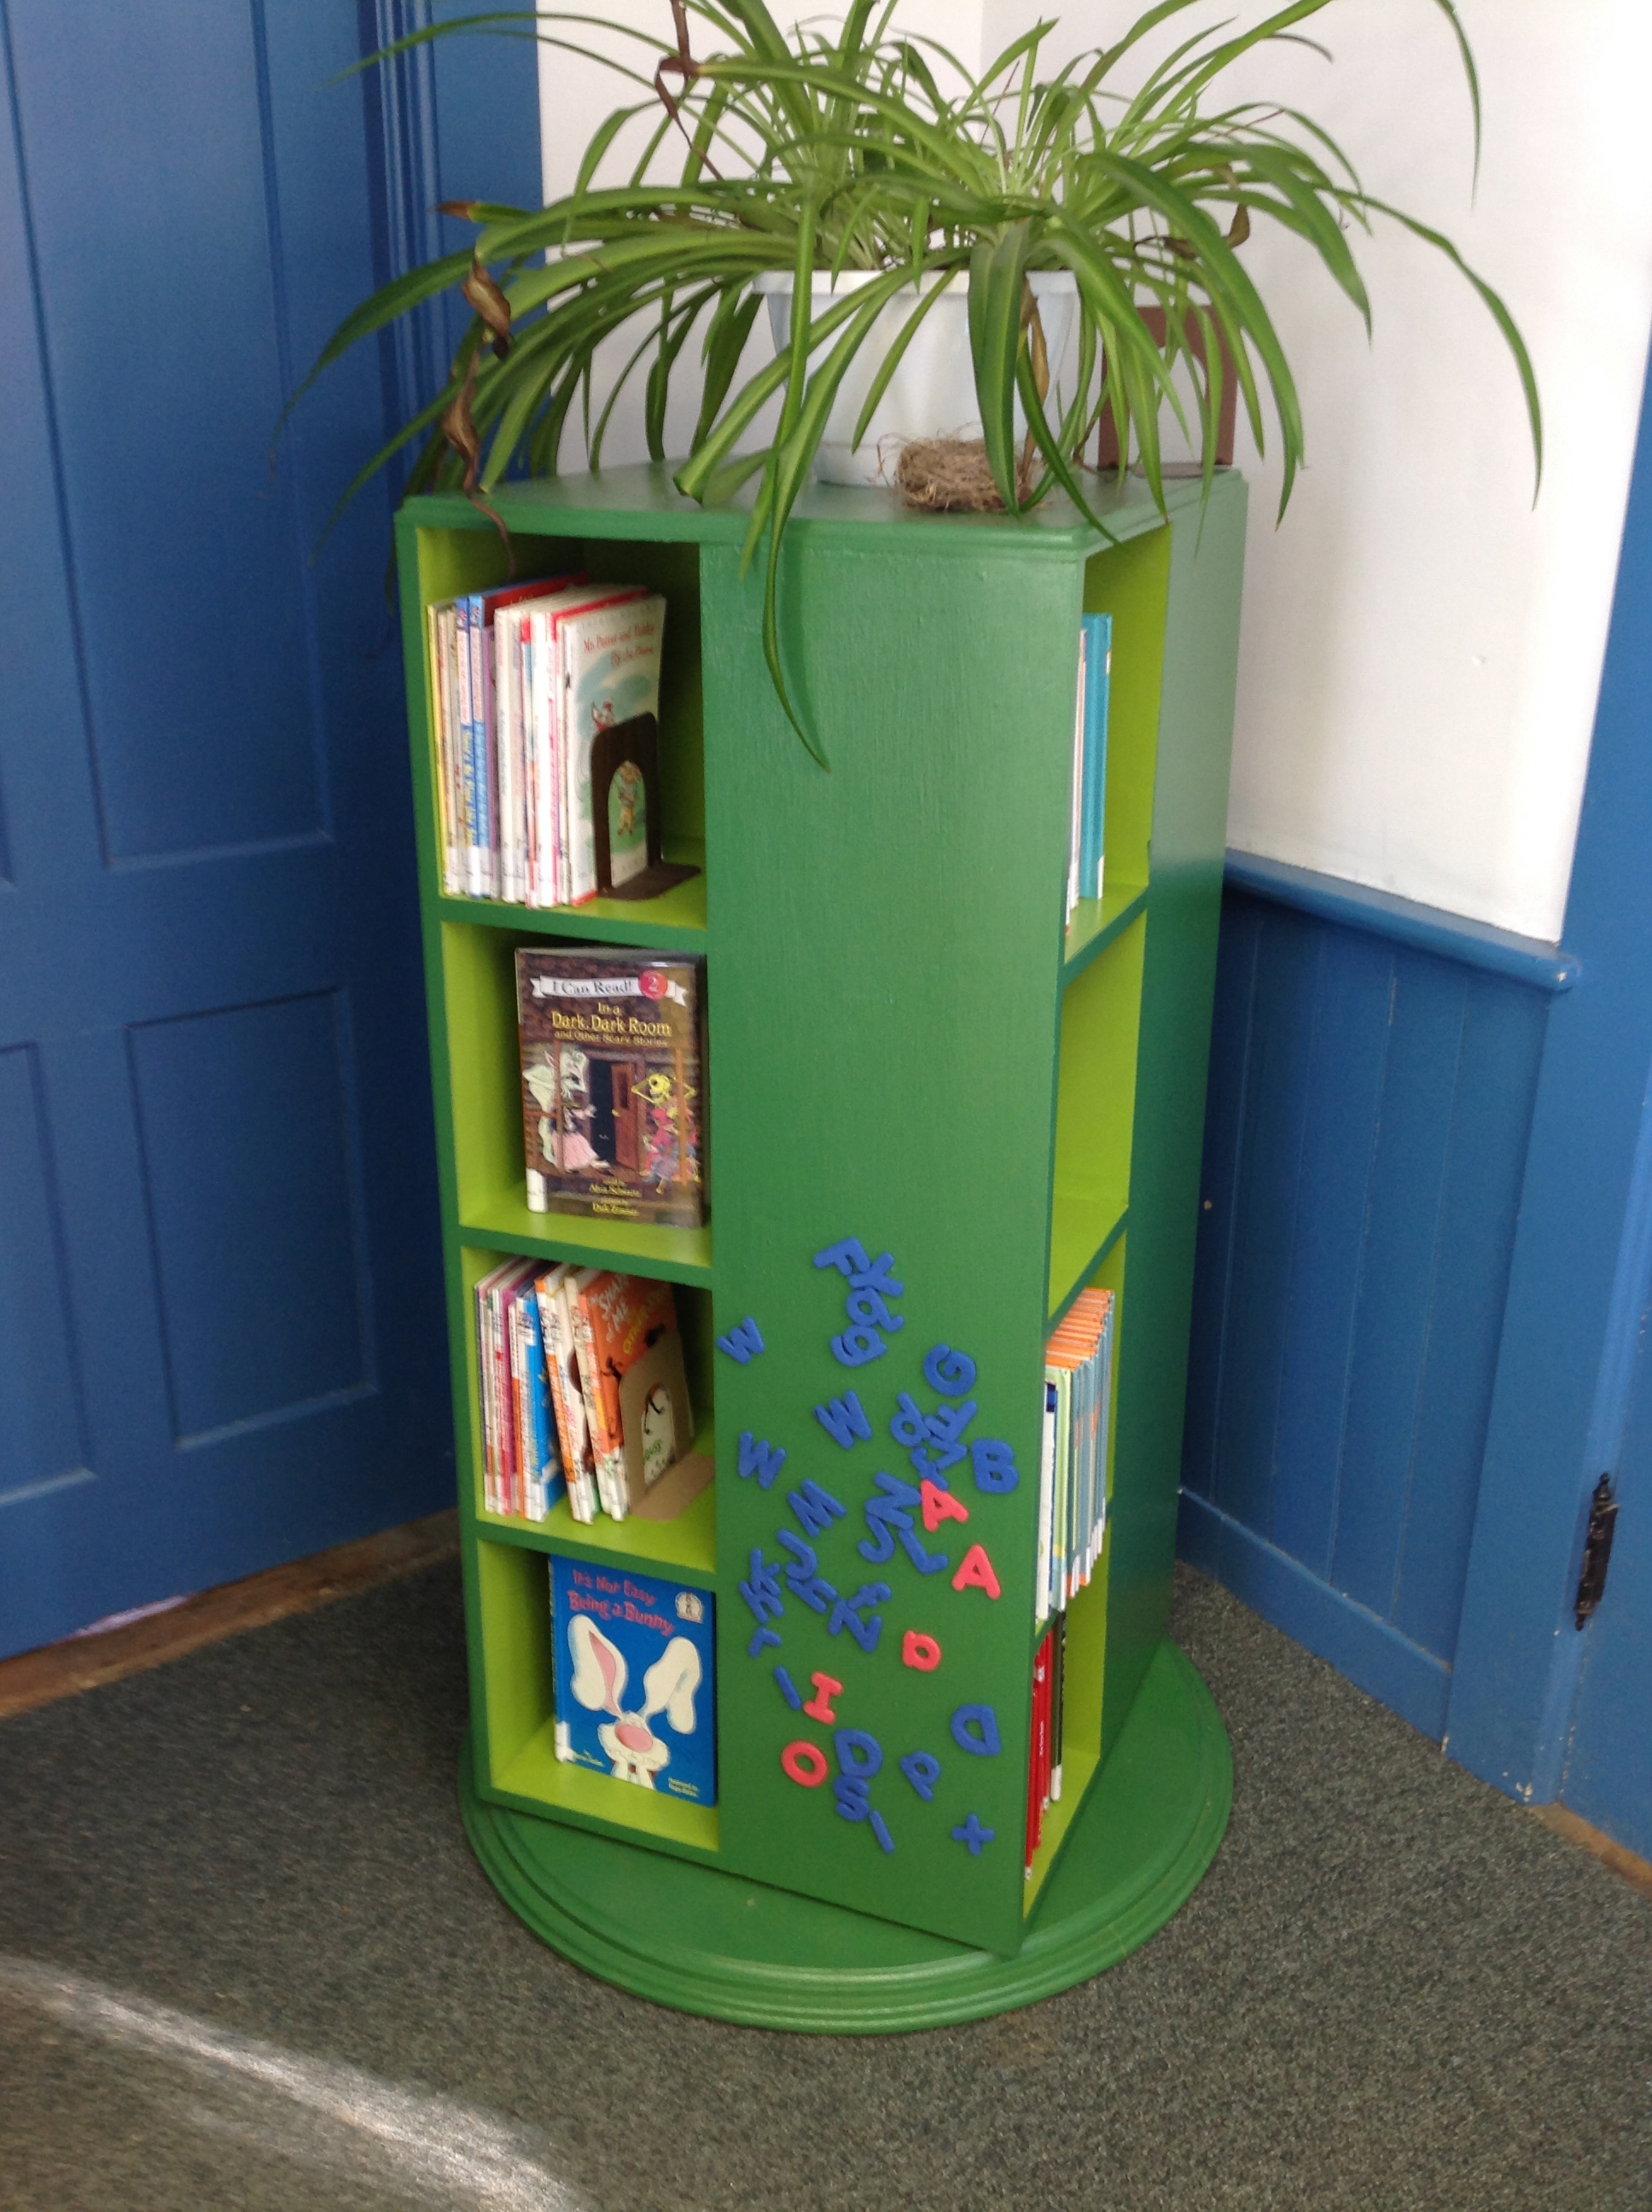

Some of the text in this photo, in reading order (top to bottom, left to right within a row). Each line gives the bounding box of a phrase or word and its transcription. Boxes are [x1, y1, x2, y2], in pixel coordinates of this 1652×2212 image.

[561, 981, 590, 995] Can
[593, 980, 632, 993] Read!
[646, 975, 660, 993] 2
[590, 1013, 626, 1033] Dark
[628, 1016, 672, 1038] Room
[597, 1001, 622, 1016] In a
[554, 1029, 573, 1040] and
[573, 1030, 599, 1041] Other
[971, 1439, 1019, 1493] B
[921, 1479, 969, 1532] A
[573, 1568, 592, 1589] It's
[596, 1575, 621, 1594] Not
[623, 1579, 657, 1608] Easy
[951, 1544, 1001, 1600] A
[567, 1588, 611, 1621] Being
[612, 1602, 623, 1618] a
[623, 1600, 674, 1638] Bunny
[781, 1739, 829, 1789] O
